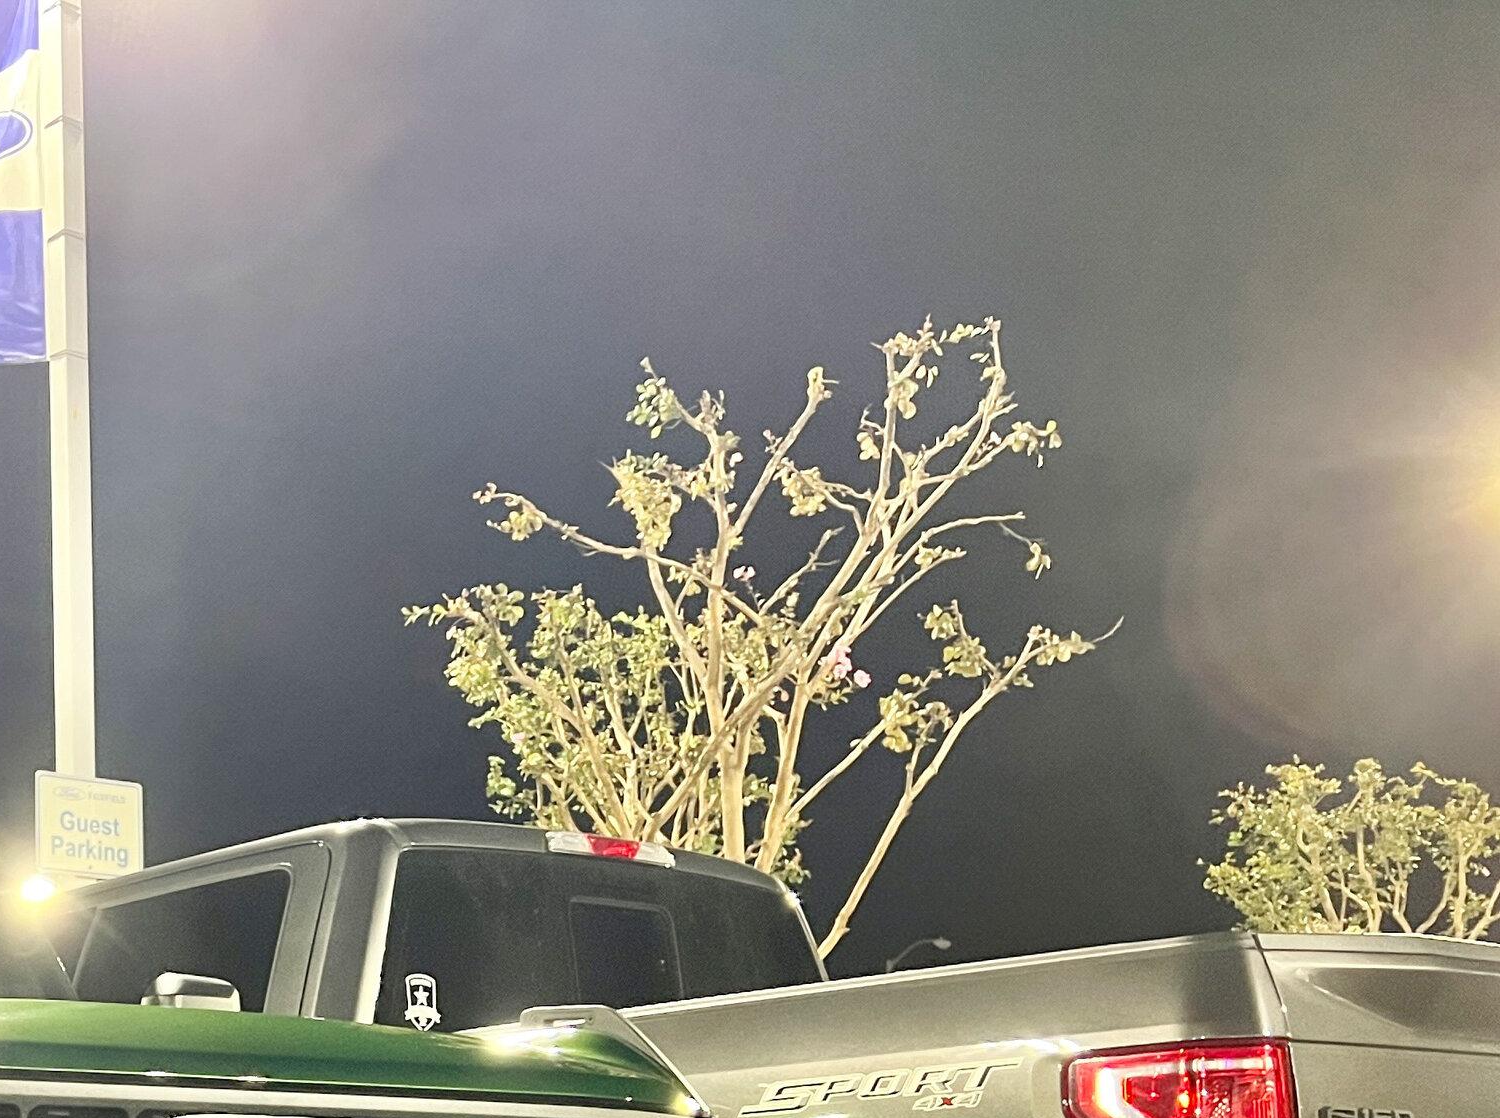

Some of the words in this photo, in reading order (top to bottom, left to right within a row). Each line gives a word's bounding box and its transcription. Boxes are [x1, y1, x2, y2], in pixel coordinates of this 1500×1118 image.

[59, 811, 121, 837] Guest
[50, 835, 130, 868] Parking
[737, 1057, 1024, 1118] SPORT
